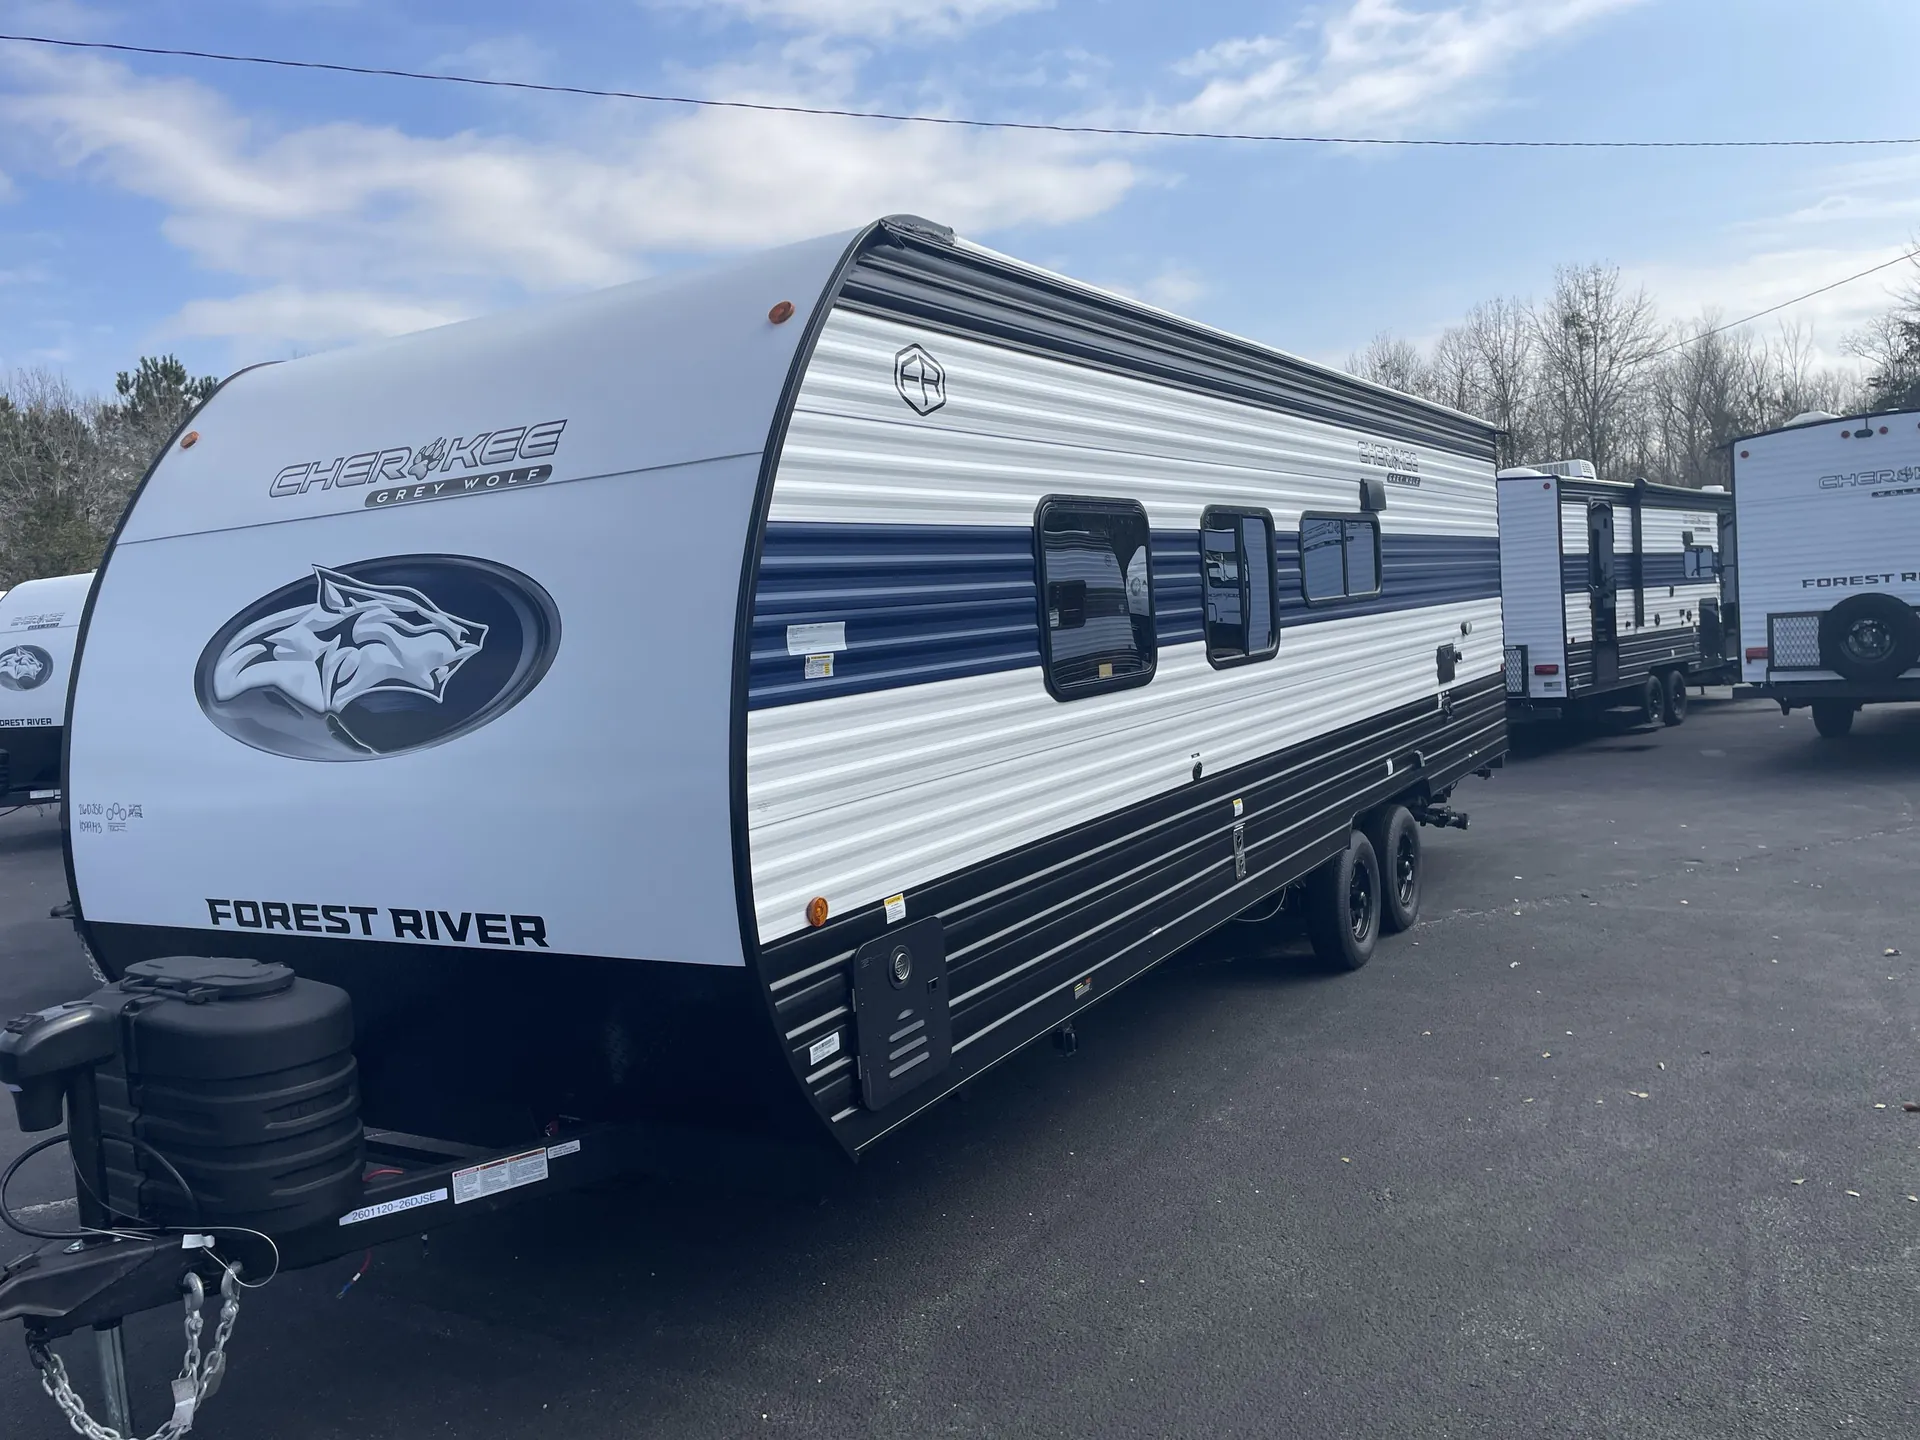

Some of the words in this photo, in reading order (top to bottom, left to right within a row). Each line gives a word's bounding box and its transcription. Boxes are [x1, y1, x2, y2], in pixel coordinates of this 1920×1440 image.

[269, 419, 568, 498] CHEROKEE
[376, 484, 445, 504] GREY
[463, 468, 541, 490] WOLF
[1819, 466, 1920, 489] CHERO
[1802, 574, 1895, 588] FOREST
[0, 718, 25, 727] OREST
[26, 717, 52, 726] RIVER
[205, 898, 378, 936] FOREST
[387, 908, 550, 948] RIVER
[352, 1192, 436, 1221] 2601120-26DJSE
